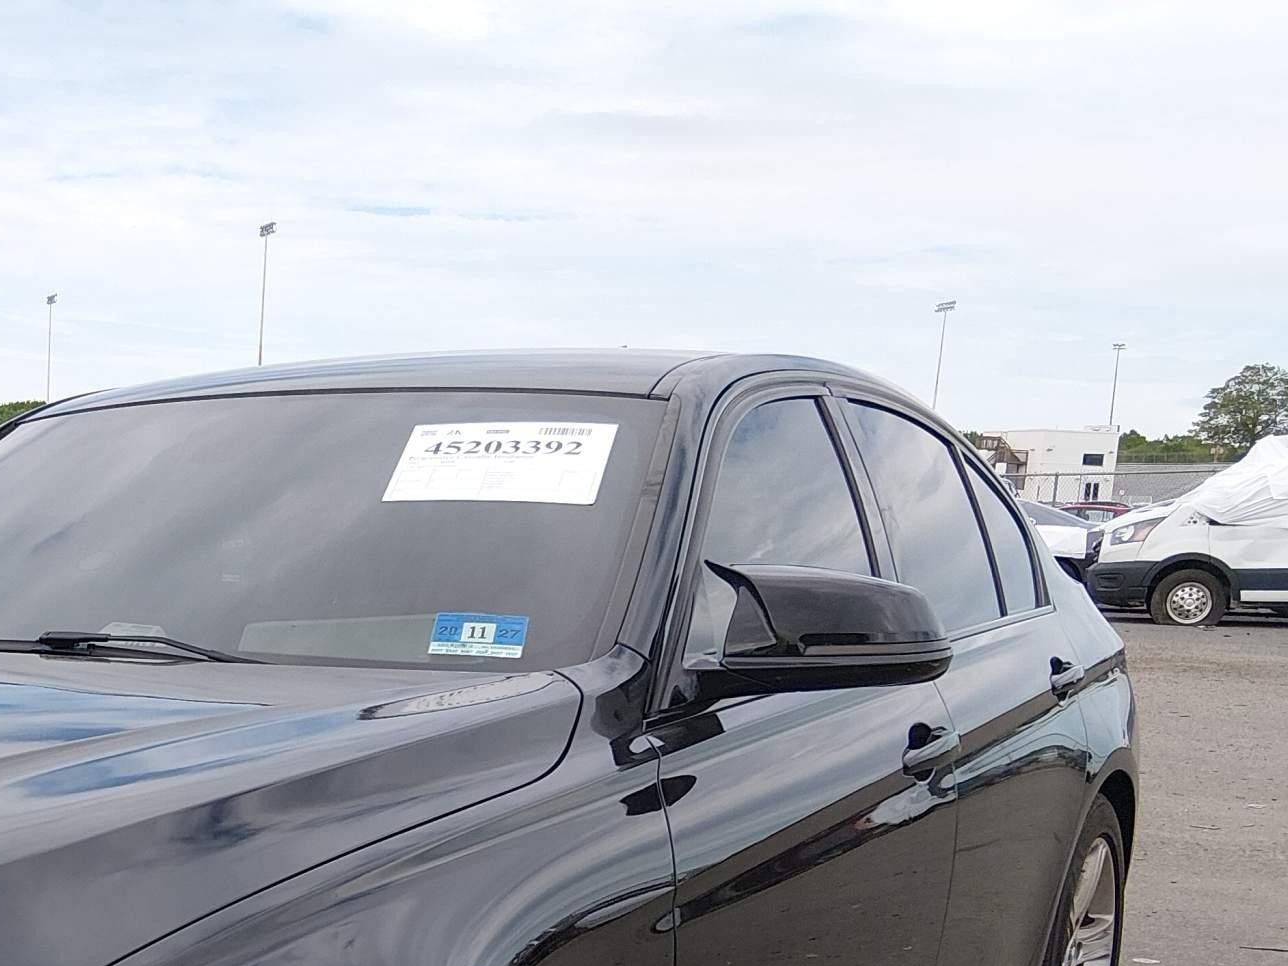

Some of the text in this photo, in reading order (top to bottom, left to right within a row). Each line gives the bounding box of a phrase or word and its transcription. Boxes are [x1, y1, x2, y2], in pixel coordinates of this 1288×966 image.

[424, 440, 583, 455] 45203392
[438, 625, 521, 639] 20 11 27
